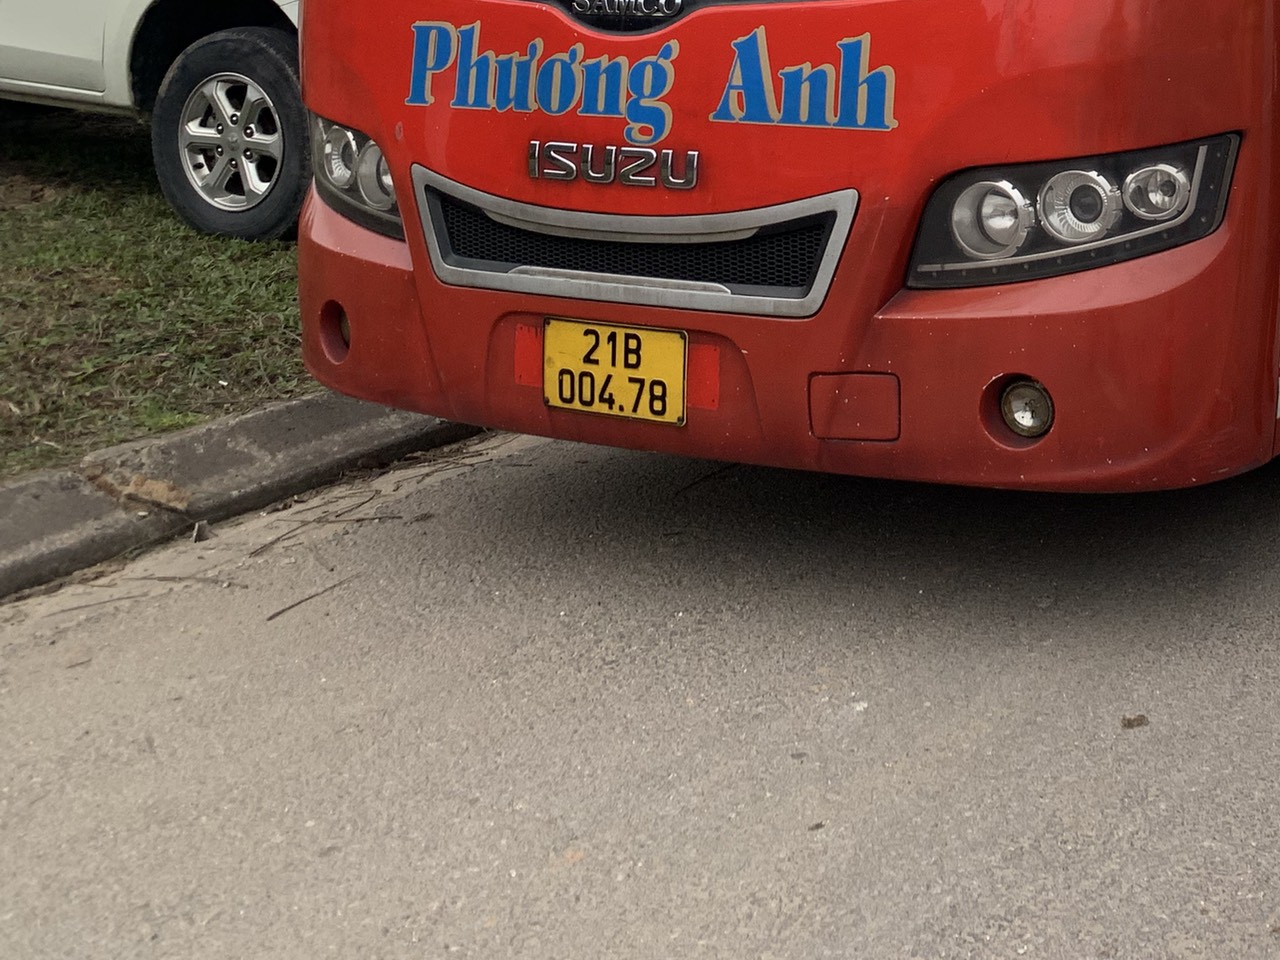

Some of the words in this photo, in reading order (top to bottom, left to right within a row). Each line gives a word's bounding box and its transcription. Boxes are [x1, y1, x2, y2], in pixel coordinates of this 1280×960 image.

[405, 20, 681, 146] Phương
[708, 24, 899, 132] Anh
[528, 140, 700, 190] ISUZU
[582, 327, 643, 370] 21B
[557, 368, 668, 417] 004.78
